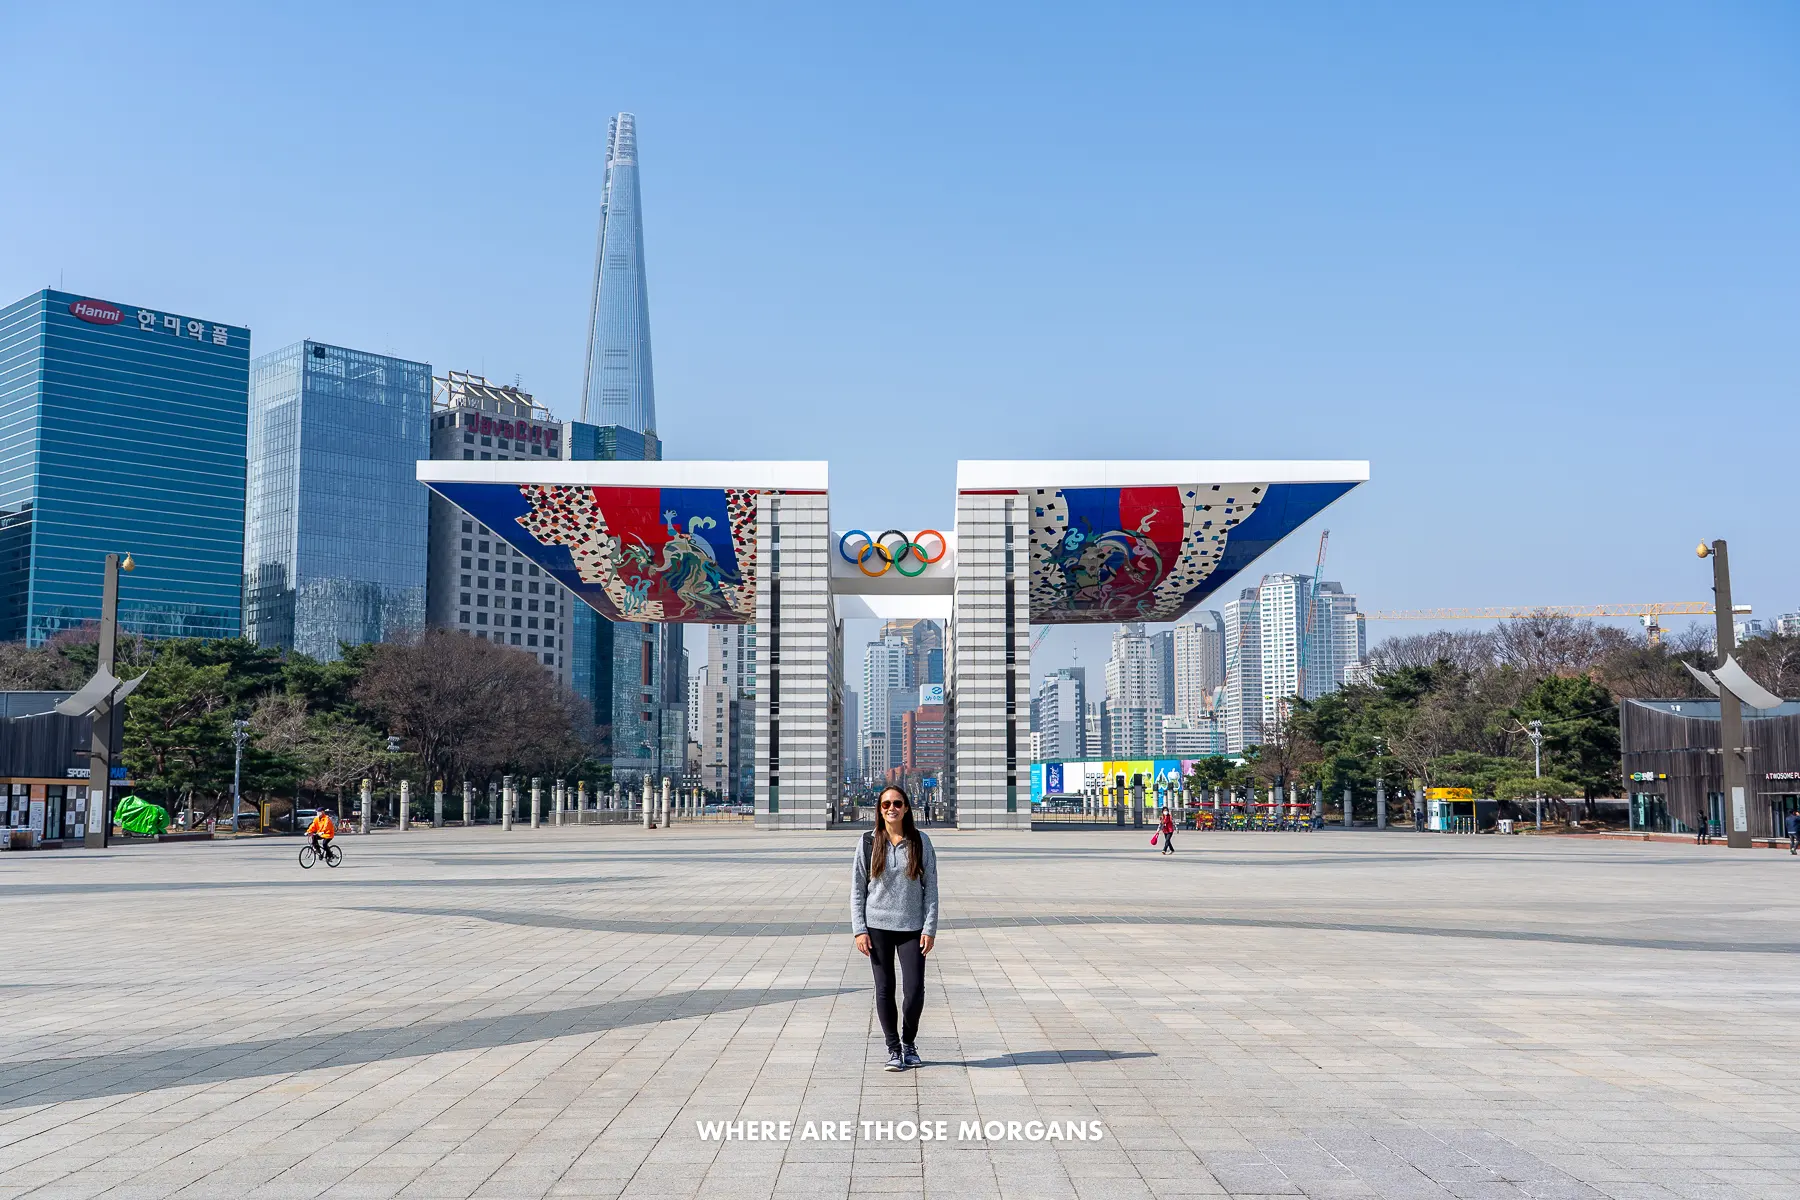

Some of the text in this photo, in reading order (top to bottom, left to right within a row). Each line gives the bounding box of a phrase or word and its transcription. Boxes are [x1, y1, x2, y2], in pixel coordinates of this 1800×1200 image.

[75, 304, 120, 321] Hanmi
[137, 310, 228, 346] 한미약품
[468, 412, 553, 449] JavaCity
[1770, 772, 1793, 780] TWOSOME
